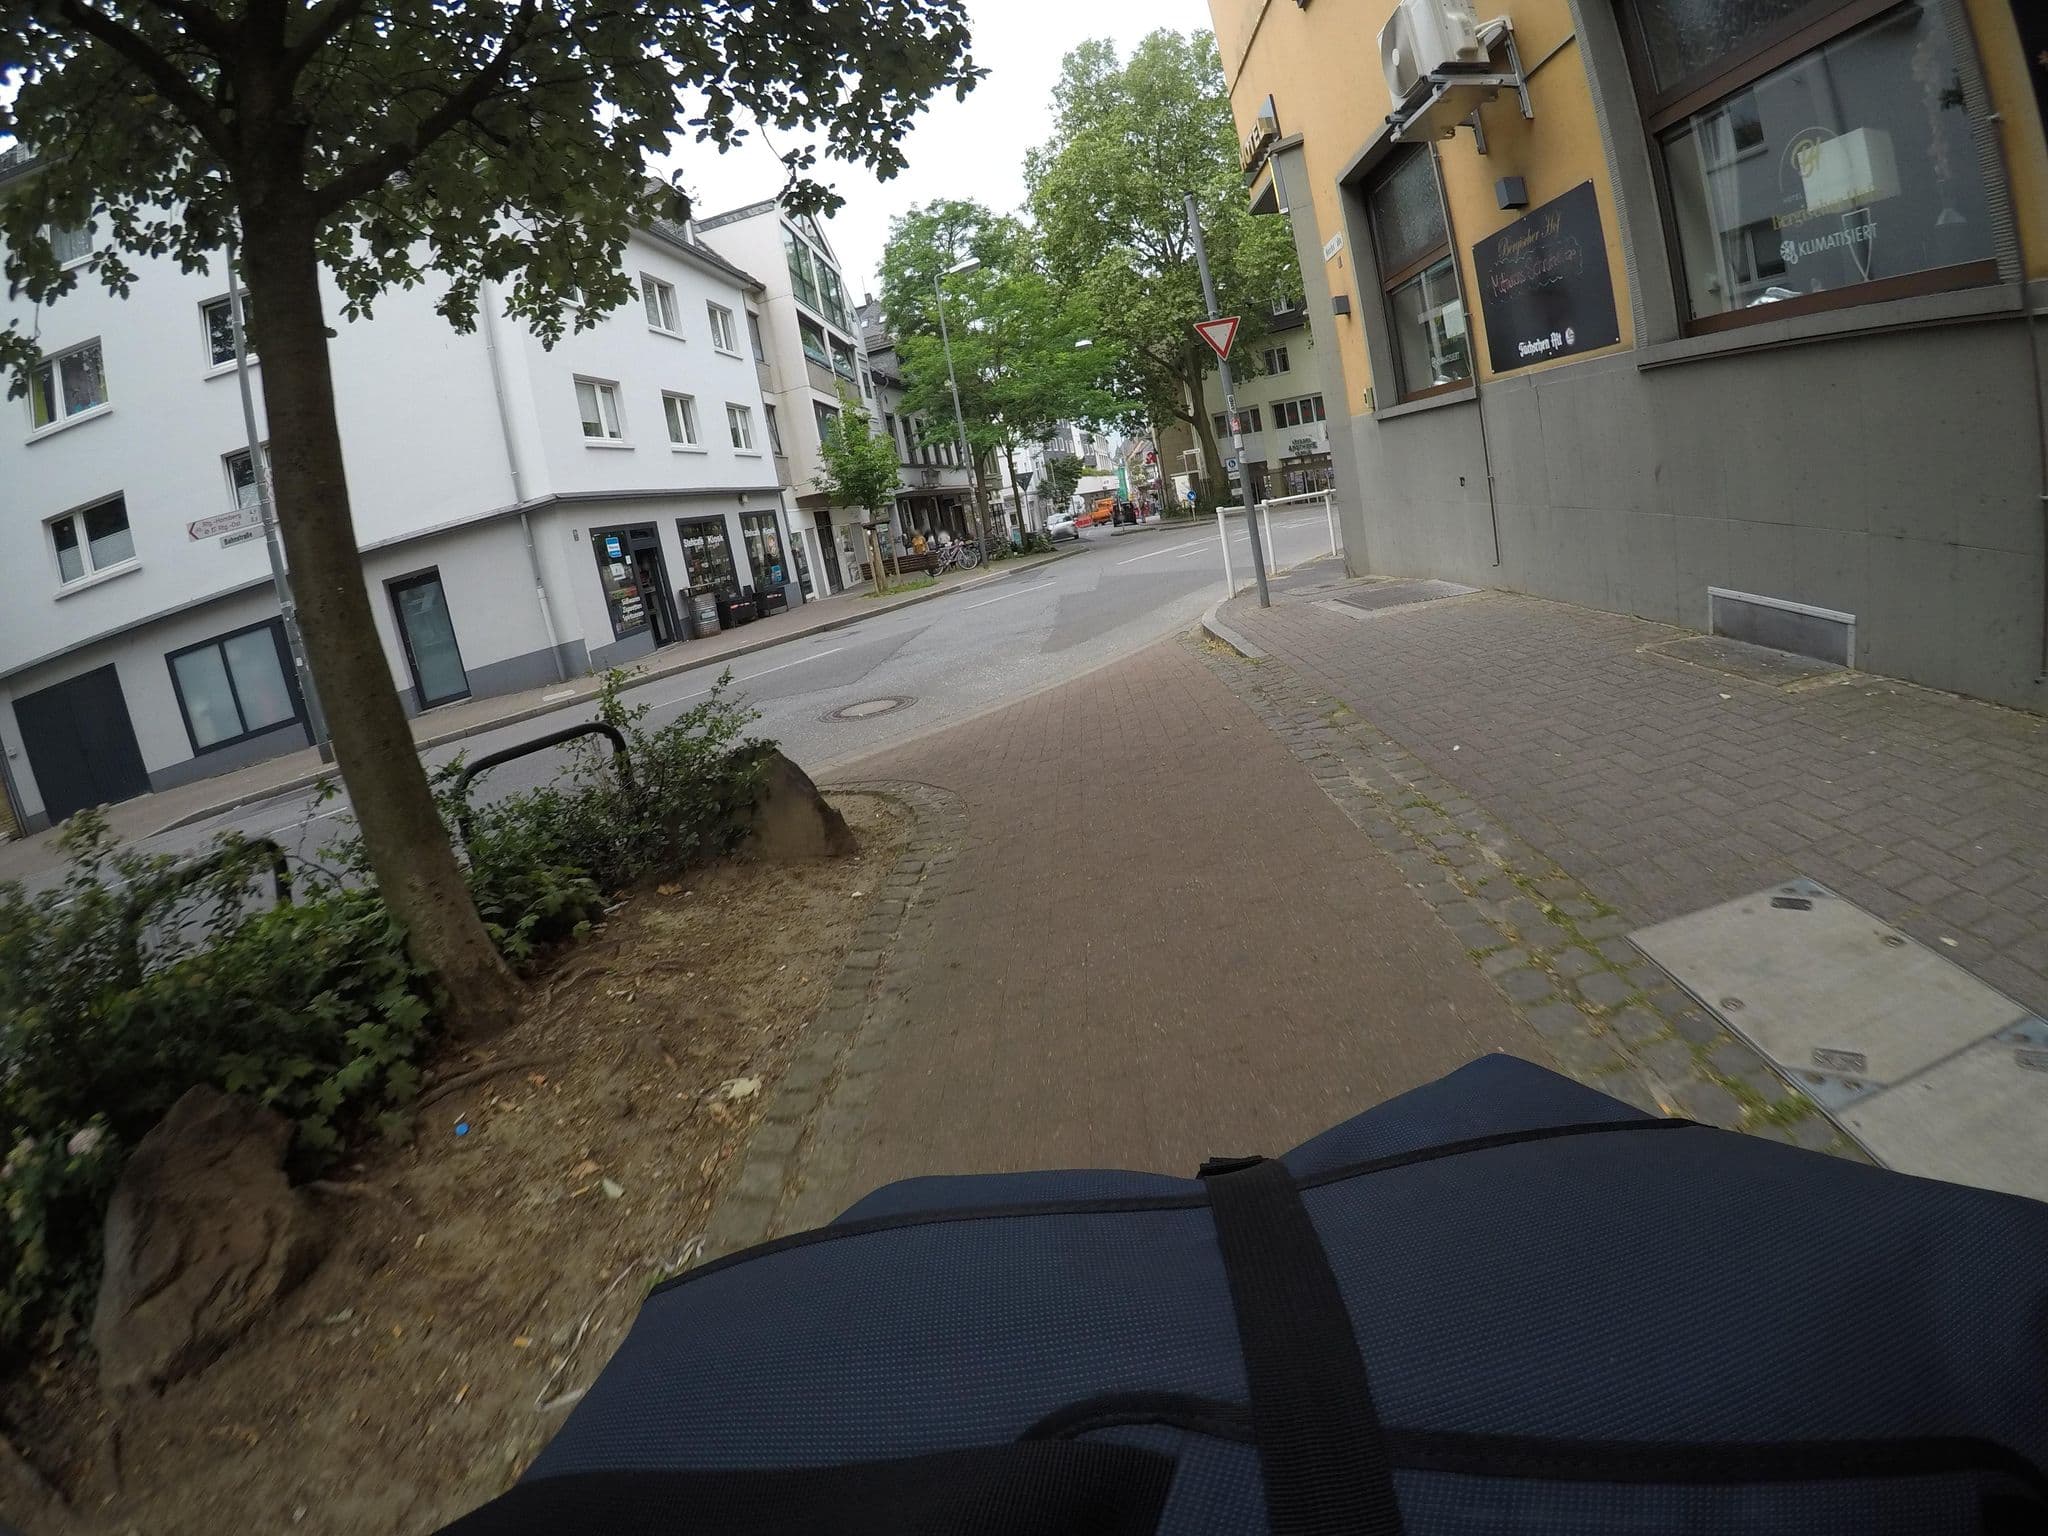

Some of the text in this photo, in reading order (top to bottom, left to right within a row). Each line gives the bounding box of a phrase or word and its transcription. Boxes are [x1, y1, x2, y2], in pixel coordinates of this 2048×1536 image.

[1239, 118, 1265, 174] HOTEL
[1799, 222, 1878, 257] KLIMATISIERT
[707, 534, 724, 544] Kiosk
